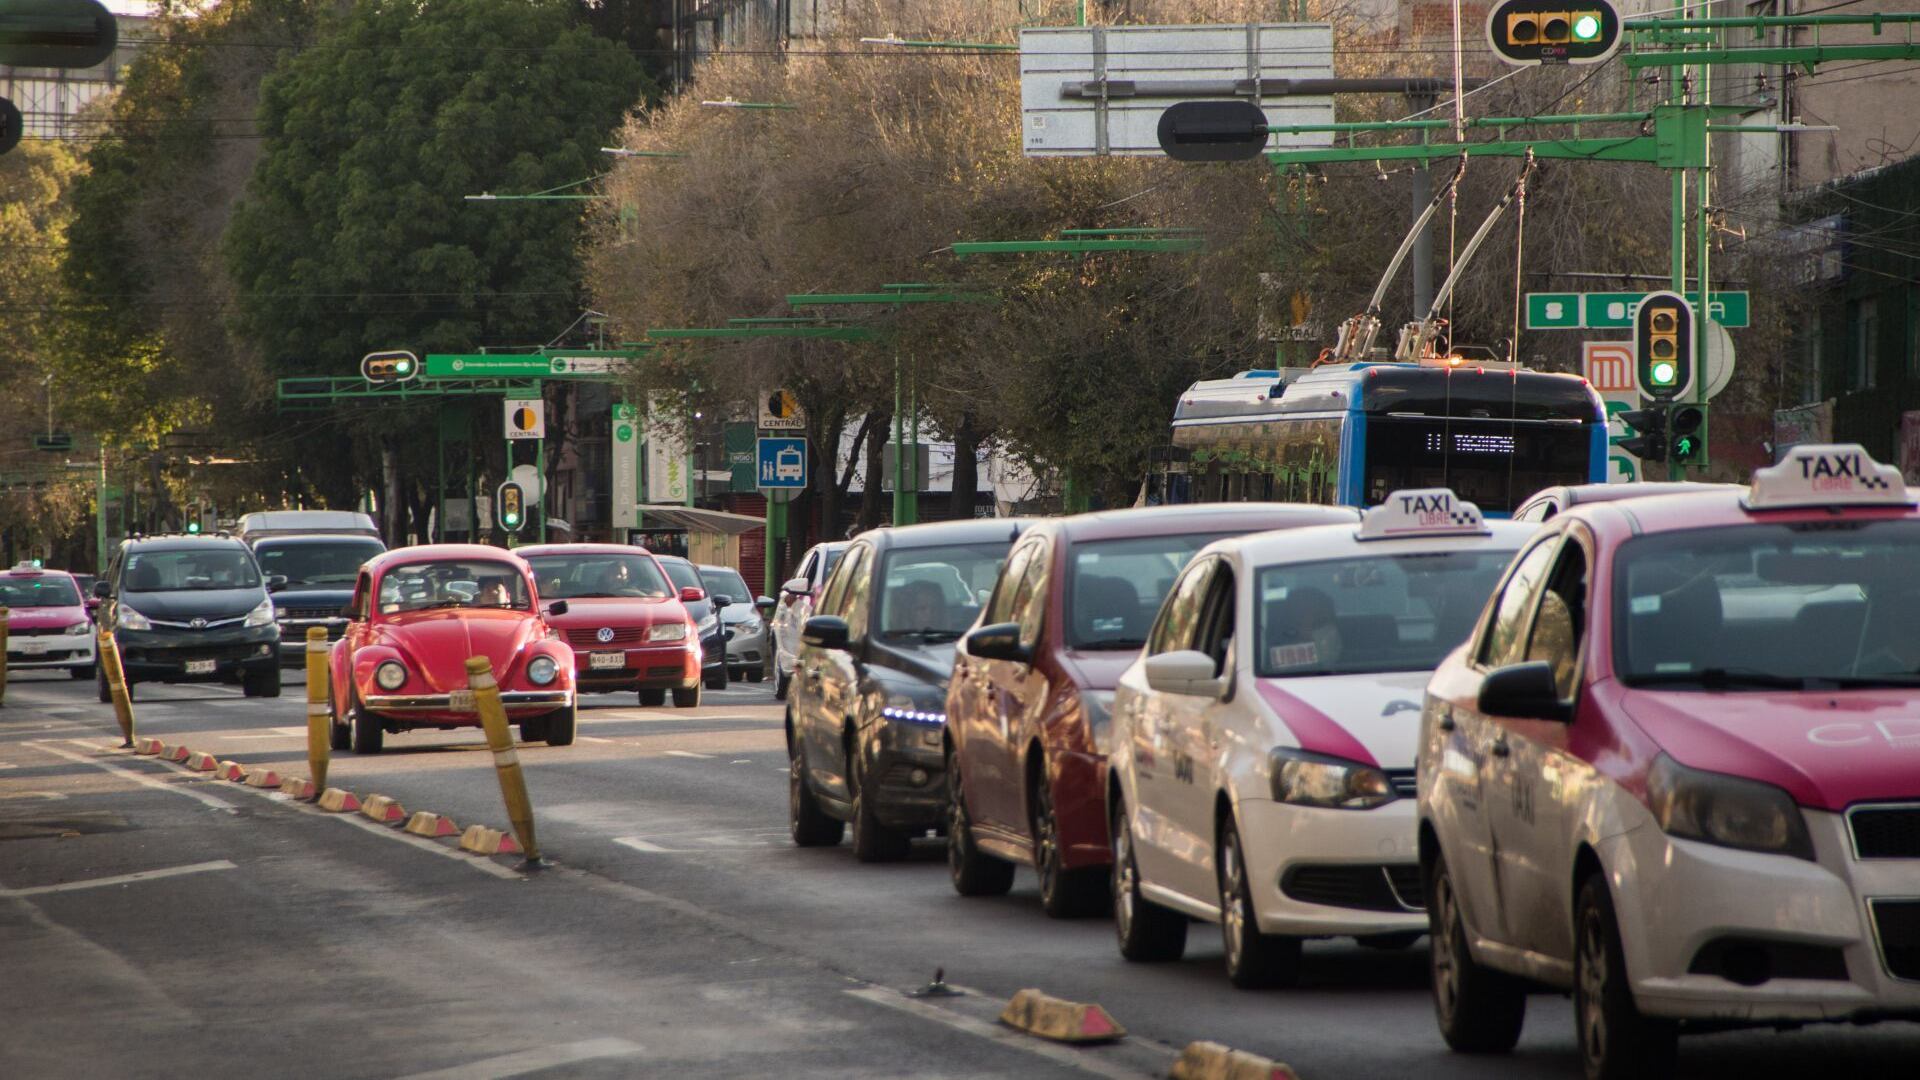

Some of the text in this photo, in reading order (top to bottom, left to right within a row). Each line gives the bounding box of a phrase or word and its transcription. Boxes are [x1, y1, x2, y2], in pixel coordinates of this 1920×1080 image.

[1541, 47, 1567, 55] CDMX
[1545, 302, 1564, 320] 8
[763, 419, 801, 428] CENTRAL
[1797, 455, 1861, 479] TAXI
[1400, 494, 1449, 514] TAXI
[1420, 512, 1450, 525] LIBRE
